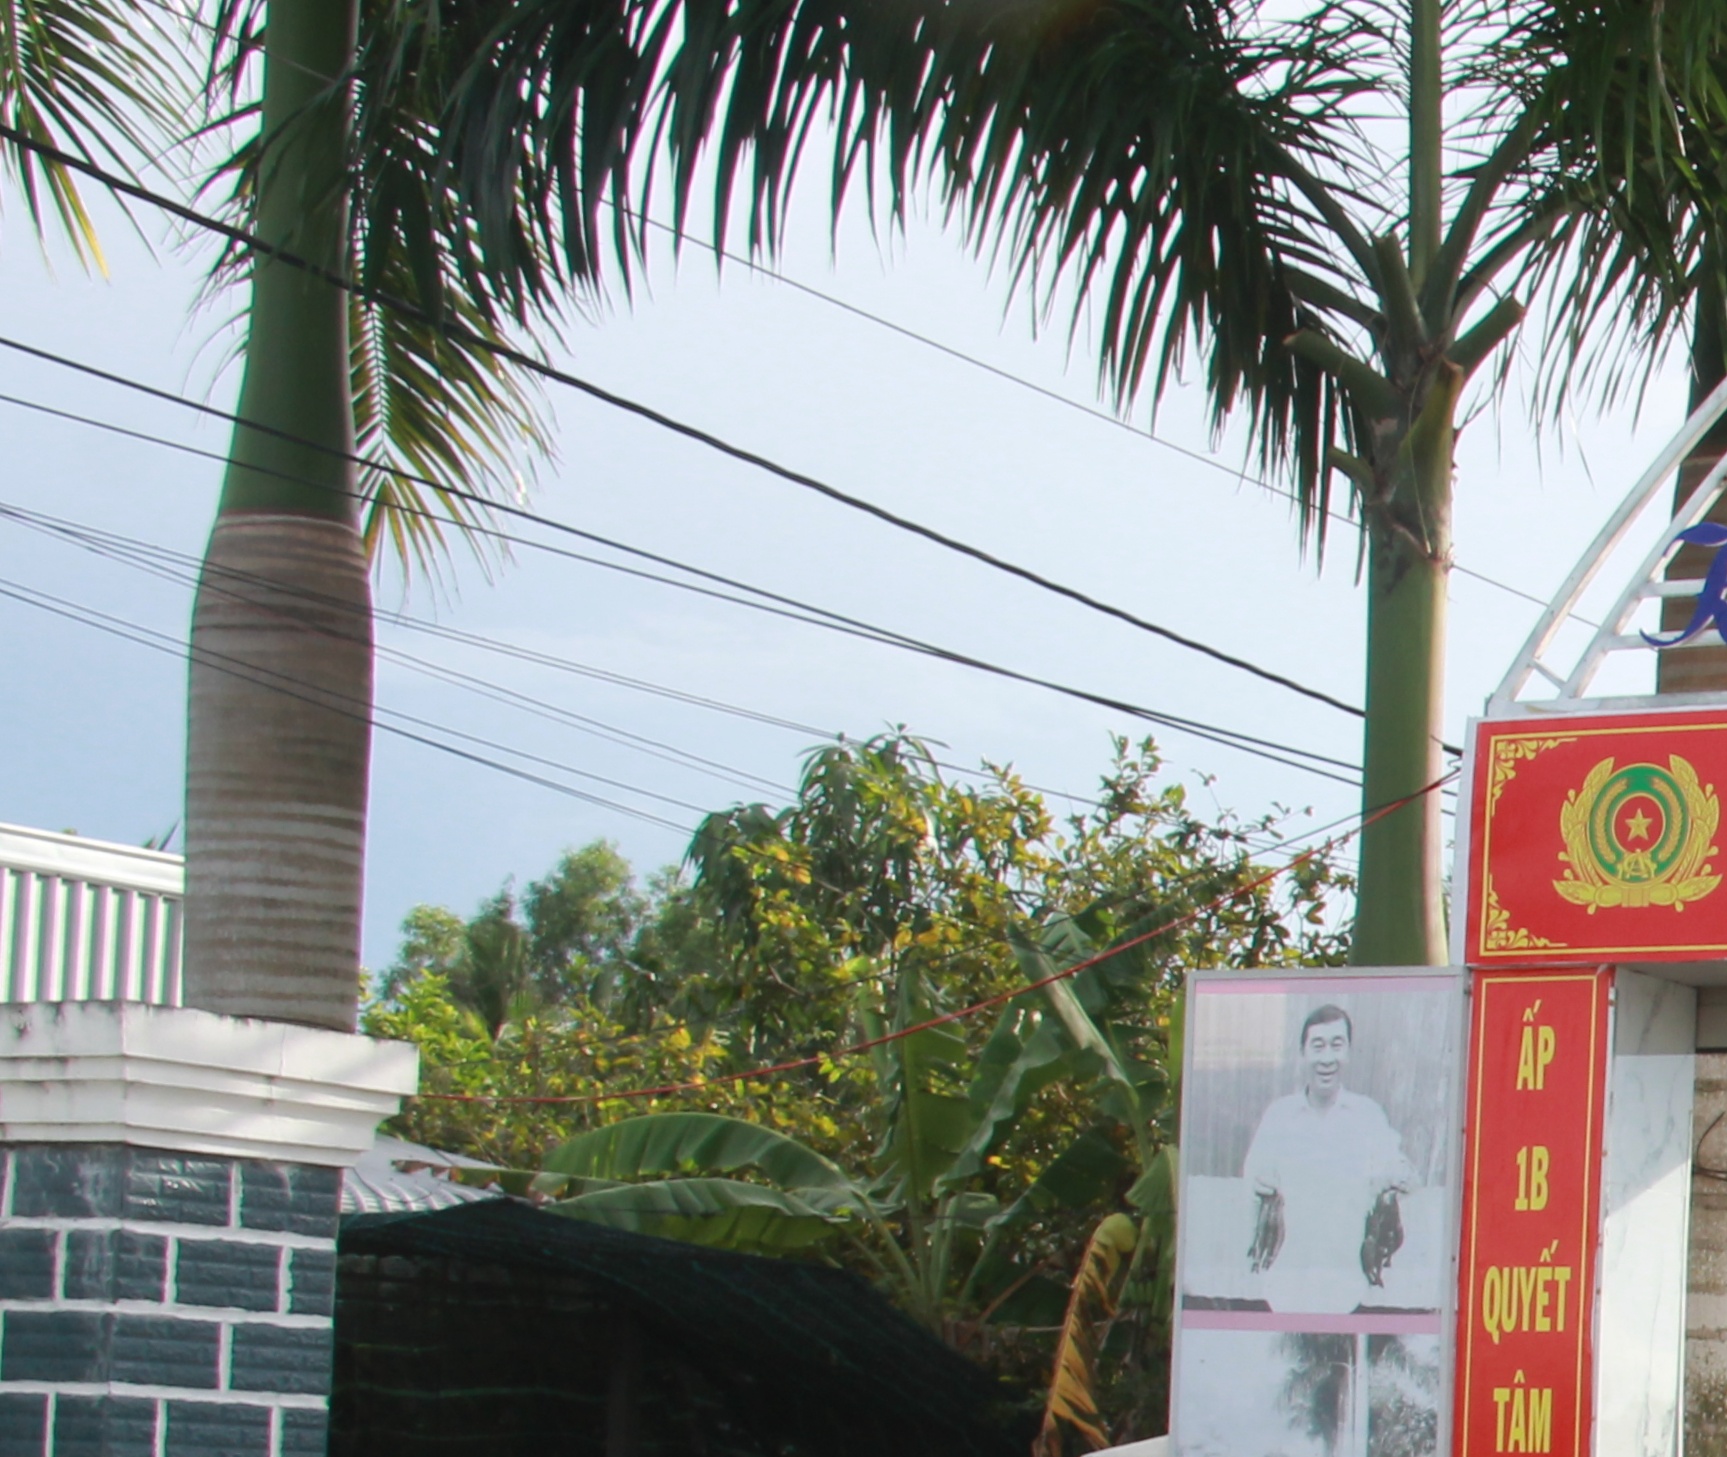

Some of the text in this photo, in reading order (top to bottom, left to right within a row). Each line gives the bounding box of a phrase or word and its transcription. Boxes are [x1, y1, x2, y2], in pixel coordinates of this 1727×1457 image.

[1515, 1000, 1557, 1091] ẤP
[1513, 1144, 1551, 1212] 1B
[1481, 1240, 1573, 1345] QUYẾT
[1492, 1370, 1553, 1454] TÂM
